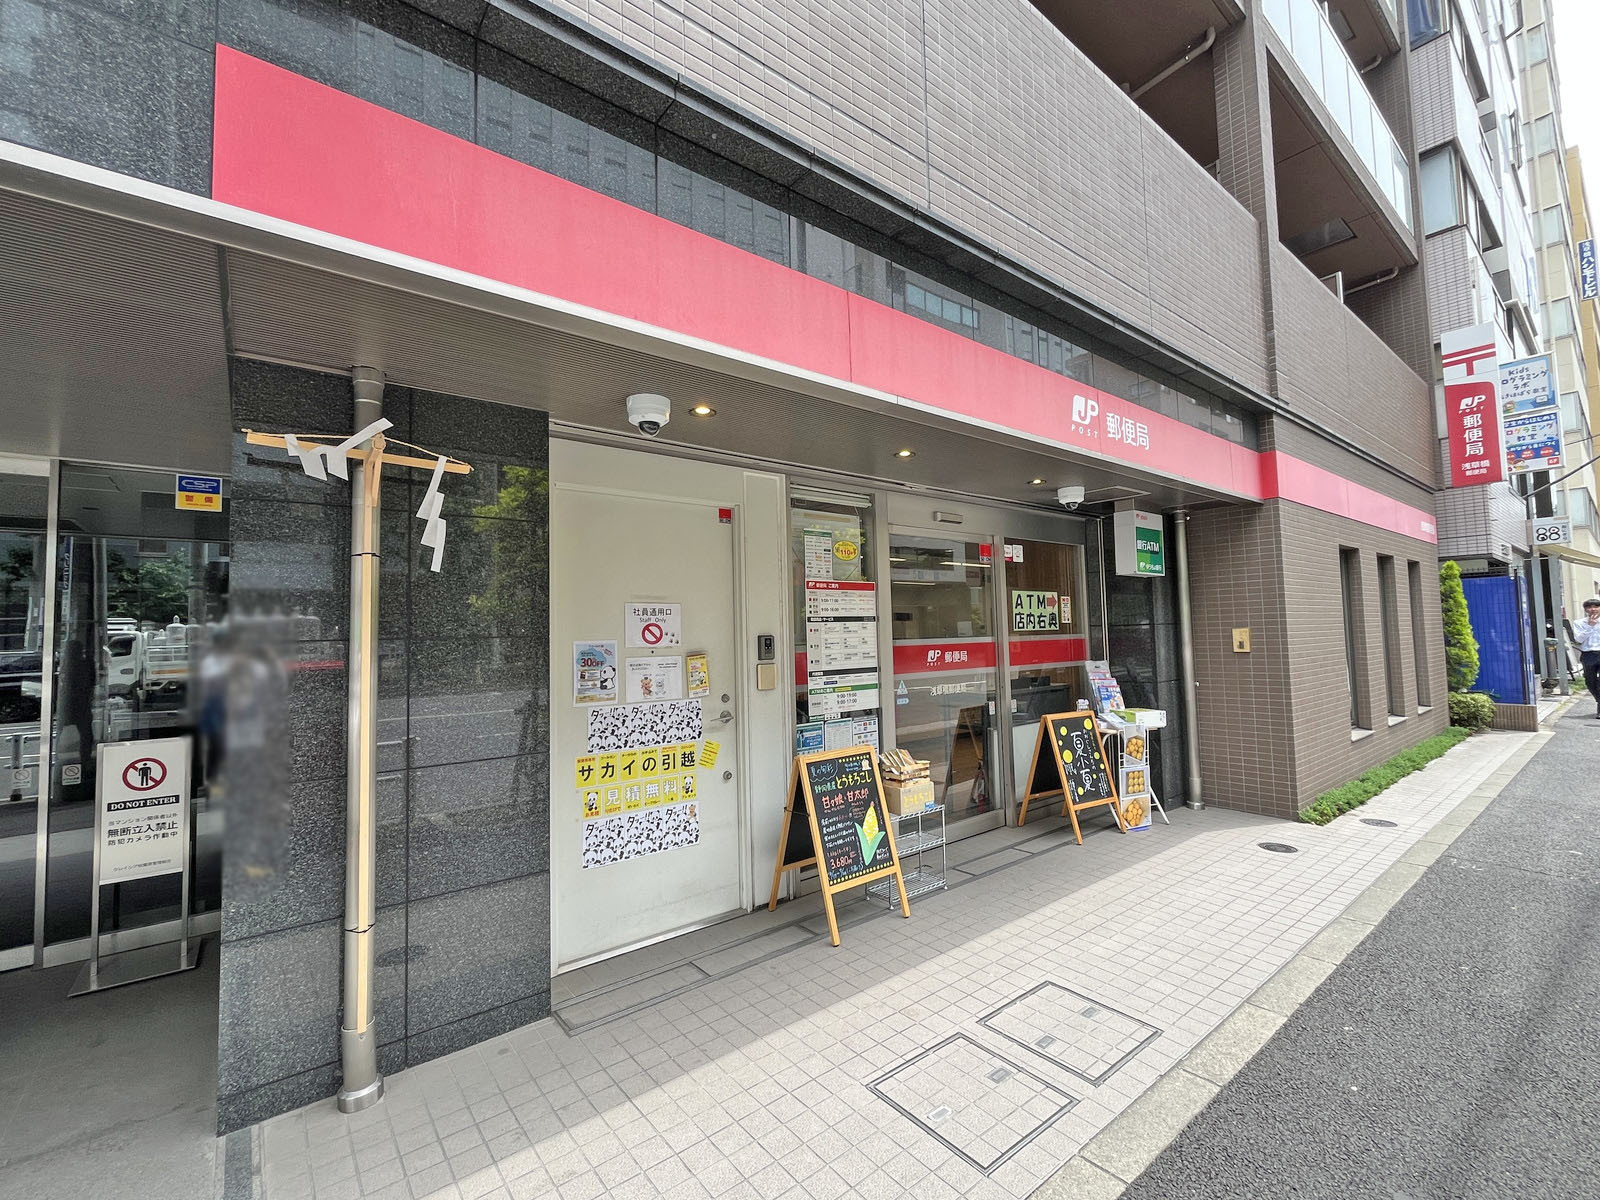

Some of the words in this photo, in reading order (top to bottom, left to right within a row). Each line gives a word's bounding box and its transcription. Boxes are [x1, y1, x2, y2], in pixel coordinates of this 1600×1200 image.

[1071, 425, 1099, 439] POST
[1106, 412, 1150, 450] 郵便局
[1463, 413, 1484, 457] 郵便局
[1015, 593, 1046, 610] ATM
[633, 608, 672, 617] 社員通用口
[1014, 612, 1058, 630] 店内右奥
[944, 650, 968, 663] 郵便局
[578, 750, 696, 782] サカイの引越
[836, 771, 872, 789] とうもろこし
[606, 780, 678, 807] 見積無料
[111, 803, 125, 811] DO
[126, 801, 146, 809] NOT
[147, 797, 176, 807] ENTER
[107, 821, 179, 839] 無断立入禁止
[107, 832, 178, 847] 防犯カメラ作動中
